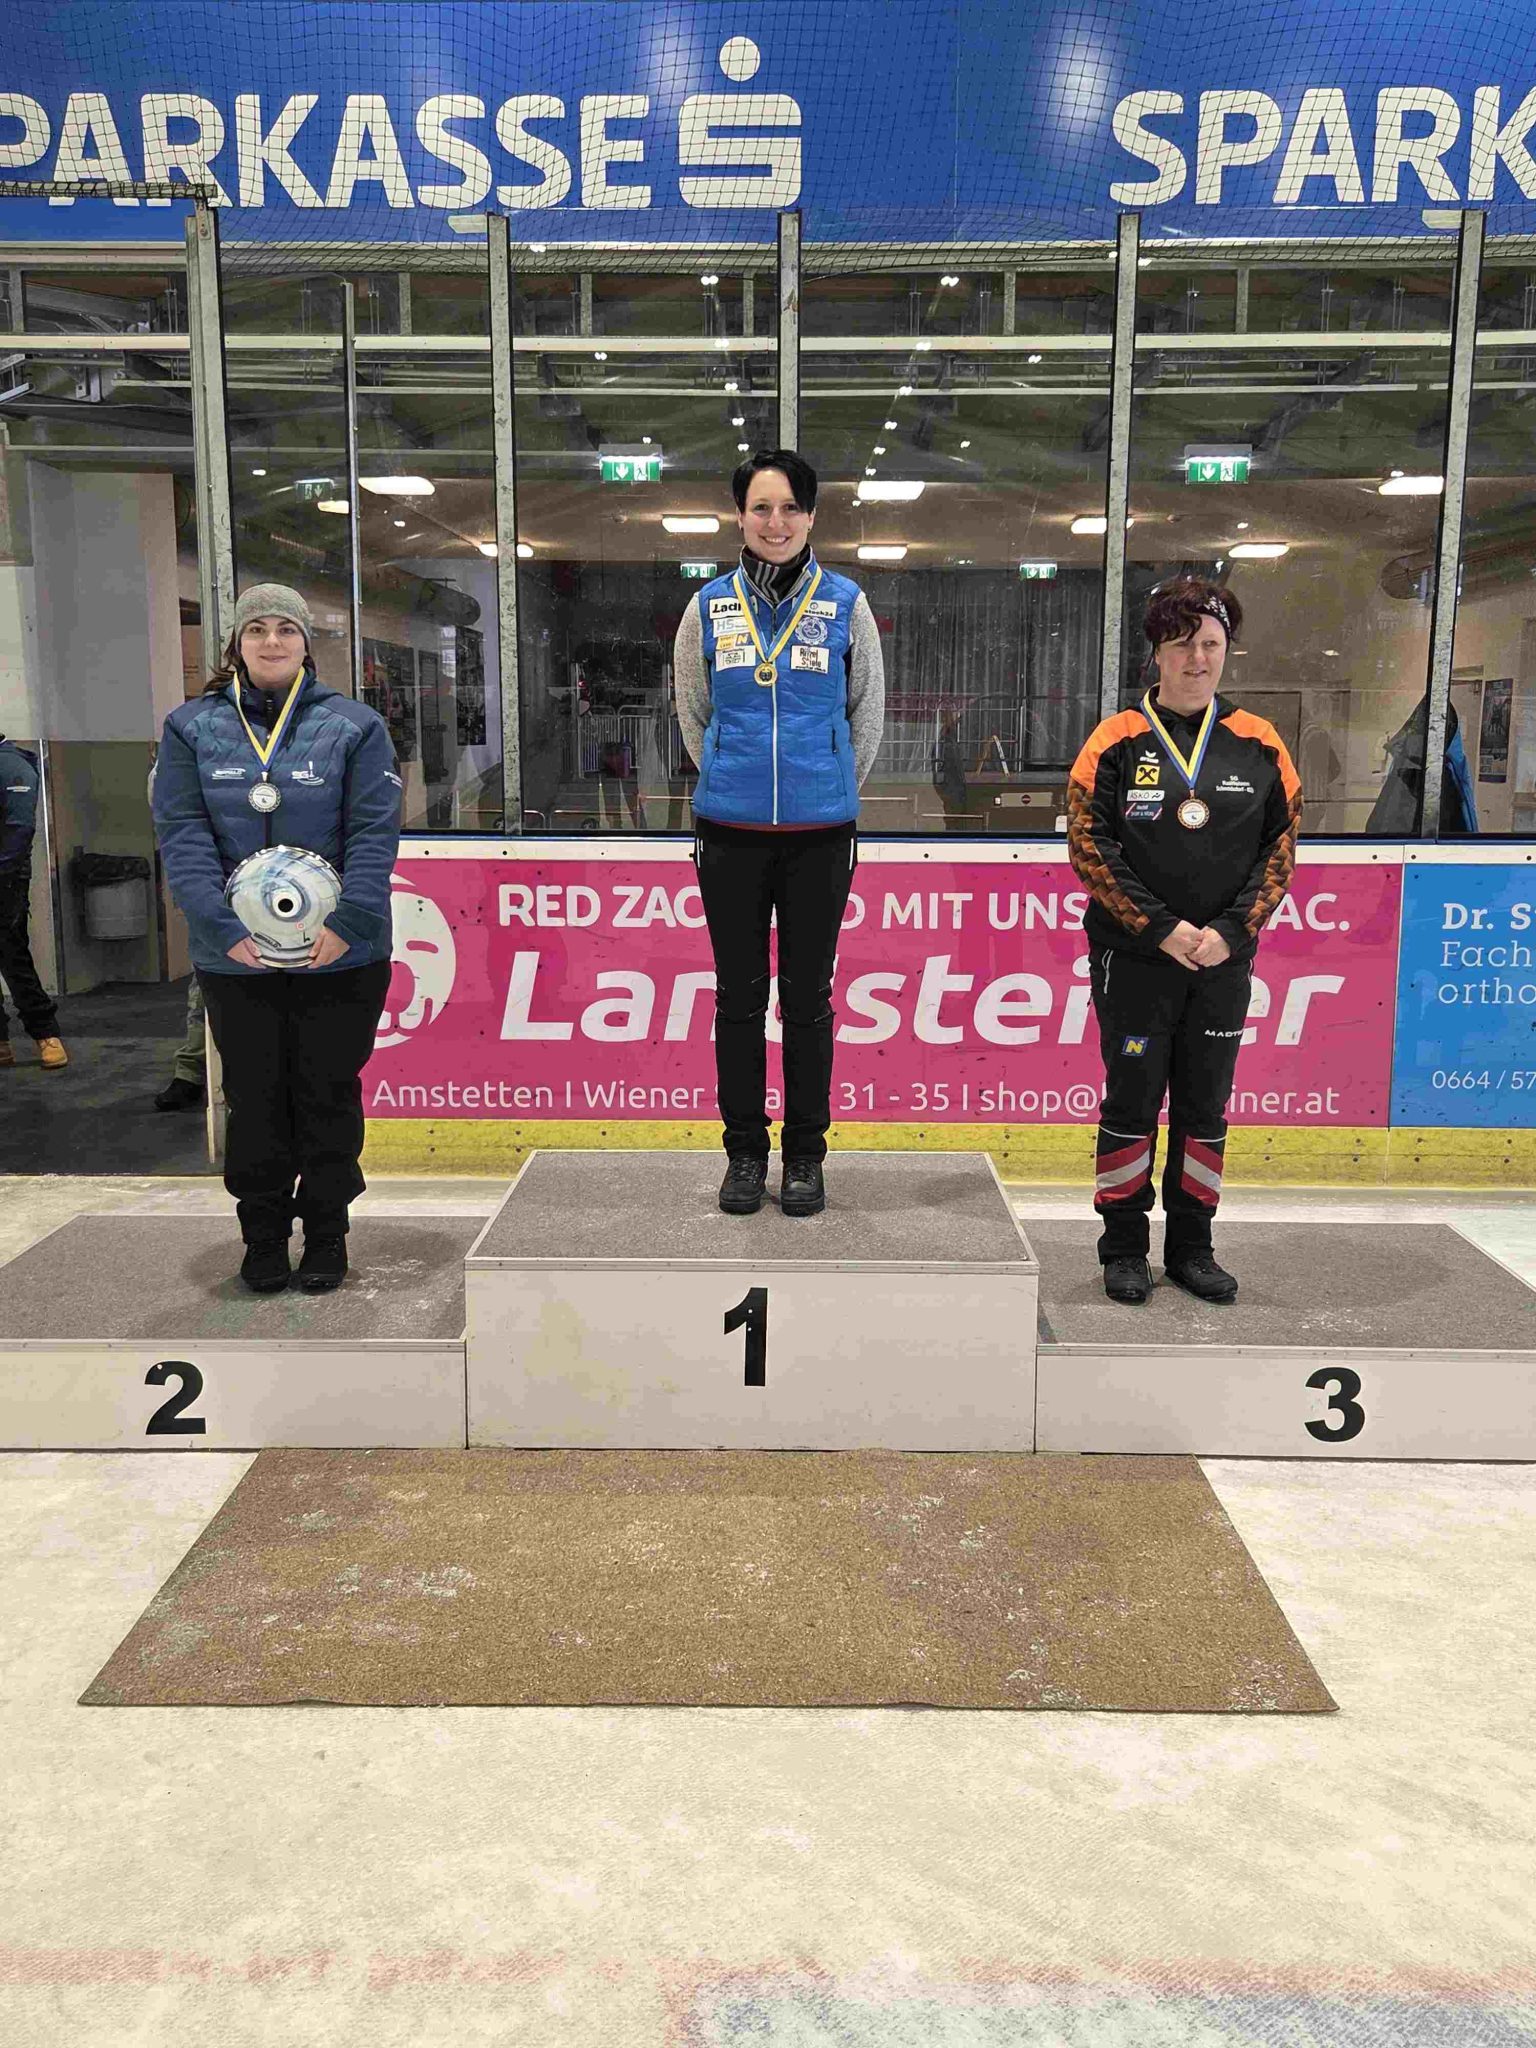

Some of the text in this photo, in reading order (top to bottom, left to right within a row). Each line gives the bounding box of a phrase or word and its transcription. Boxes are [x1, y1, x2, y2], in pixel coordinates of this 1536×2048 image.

[1109, 86, 1536, 206] SPARK
[499, 884, 601, 927] RED
[612, 885, 708, 928] ZAC
[882, 892, 973, 930] MIT
[988, 892, 1089, 931] UNS
[1259, 892, 1351, 932] AC.
[1442, 902, 1536, 930] Dr. S
[372, 1079, 553, 1108] Amstetten
[583, 1079, 706, 1108] Wiener
[839, 1082, 876, 1111] 31
[910, 1082, 950, 1111] 35
[1432, 1070, 1491, 1089] 0664
[724, 1287, 768, 1387] 1
[144, 1360, 207, 1436] 2
[1304, 1366, 1366, 1443] 3
